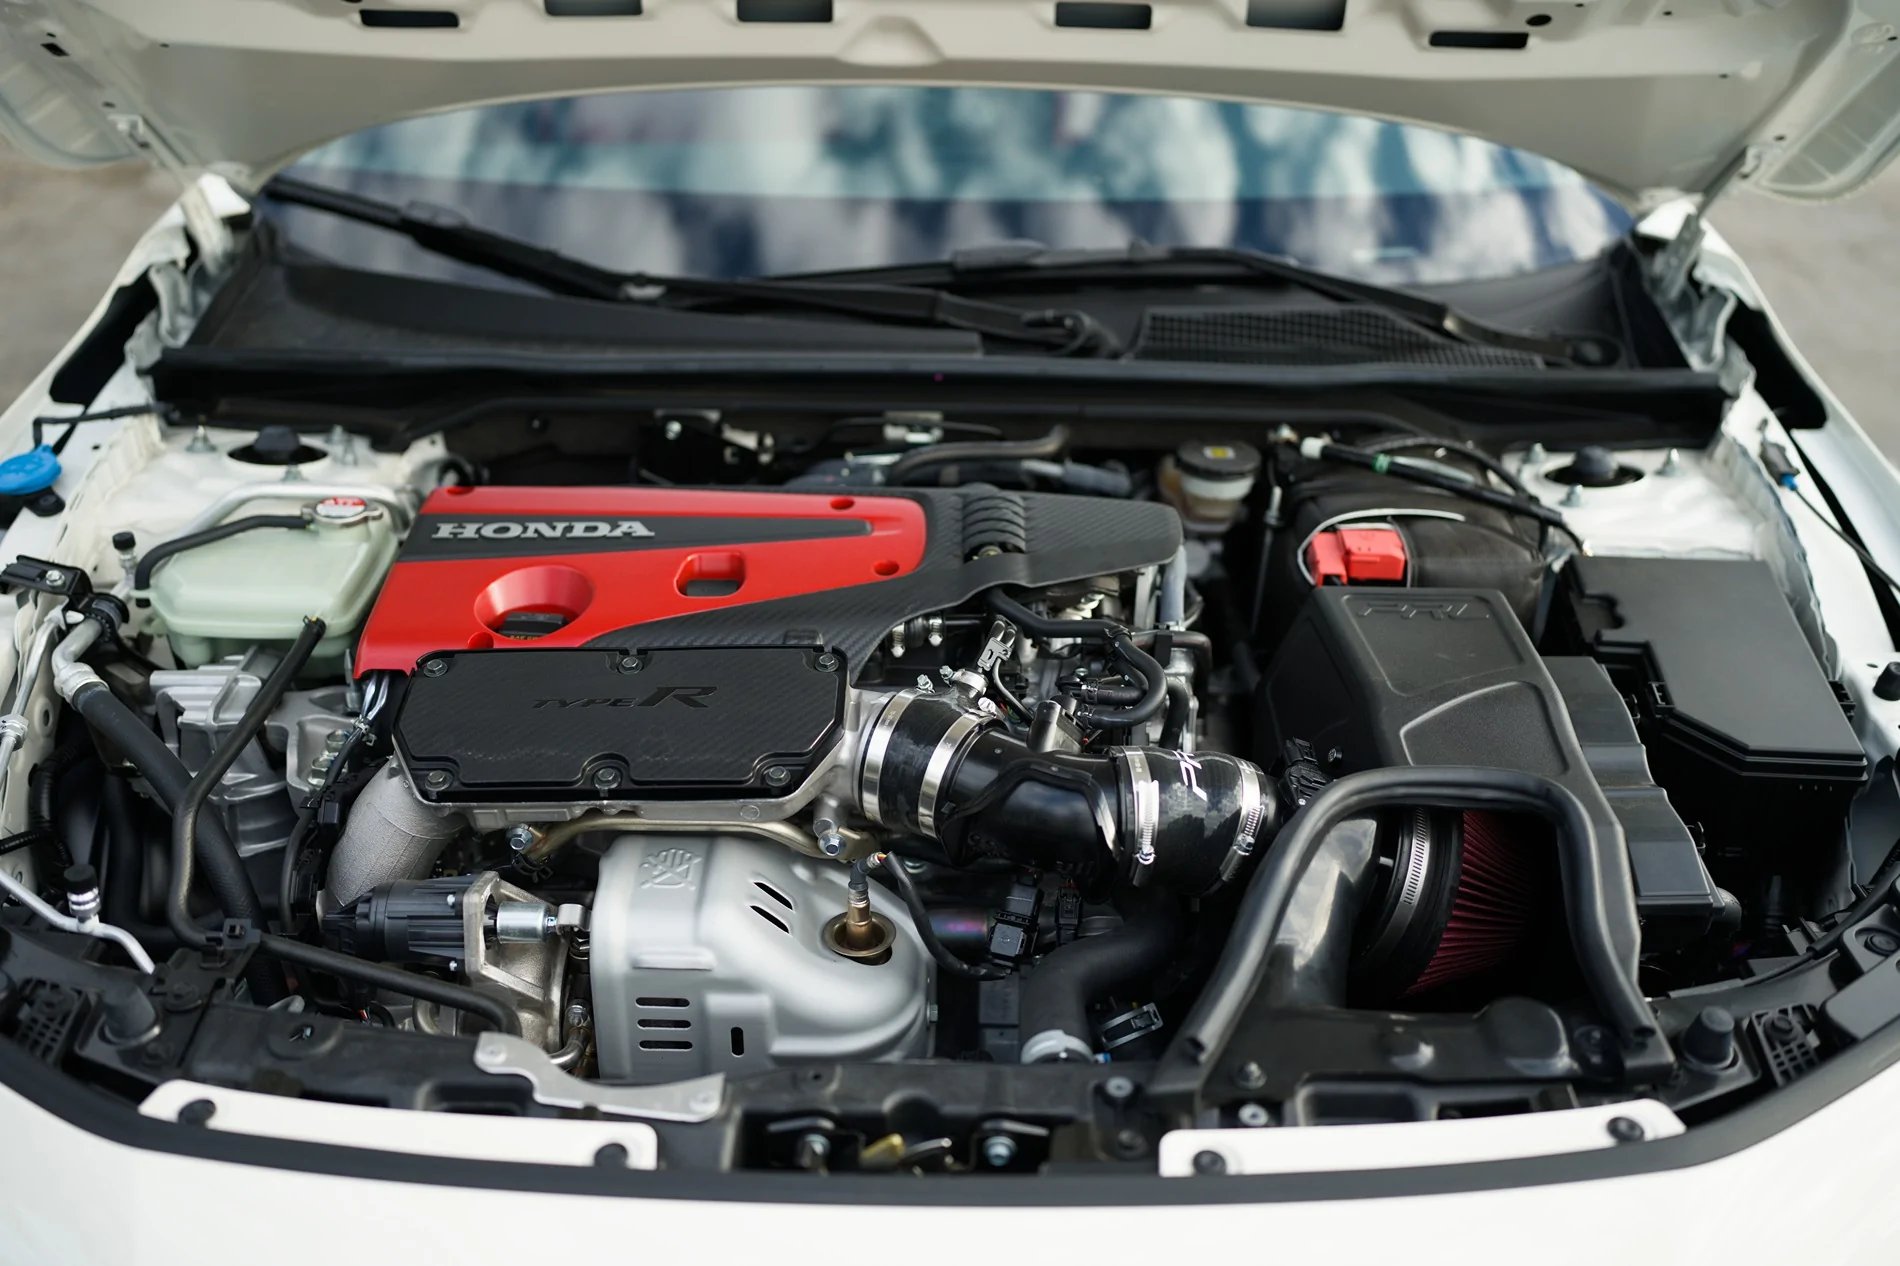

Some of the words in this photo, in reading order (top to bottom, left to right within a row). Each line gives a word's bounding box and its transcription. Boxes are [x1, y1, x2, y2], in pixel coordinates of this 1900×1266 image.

[431, 520, 656, 540] HONDA
[532, 697, 637, 709] TYPE
[636, 686, 717, 708] R
